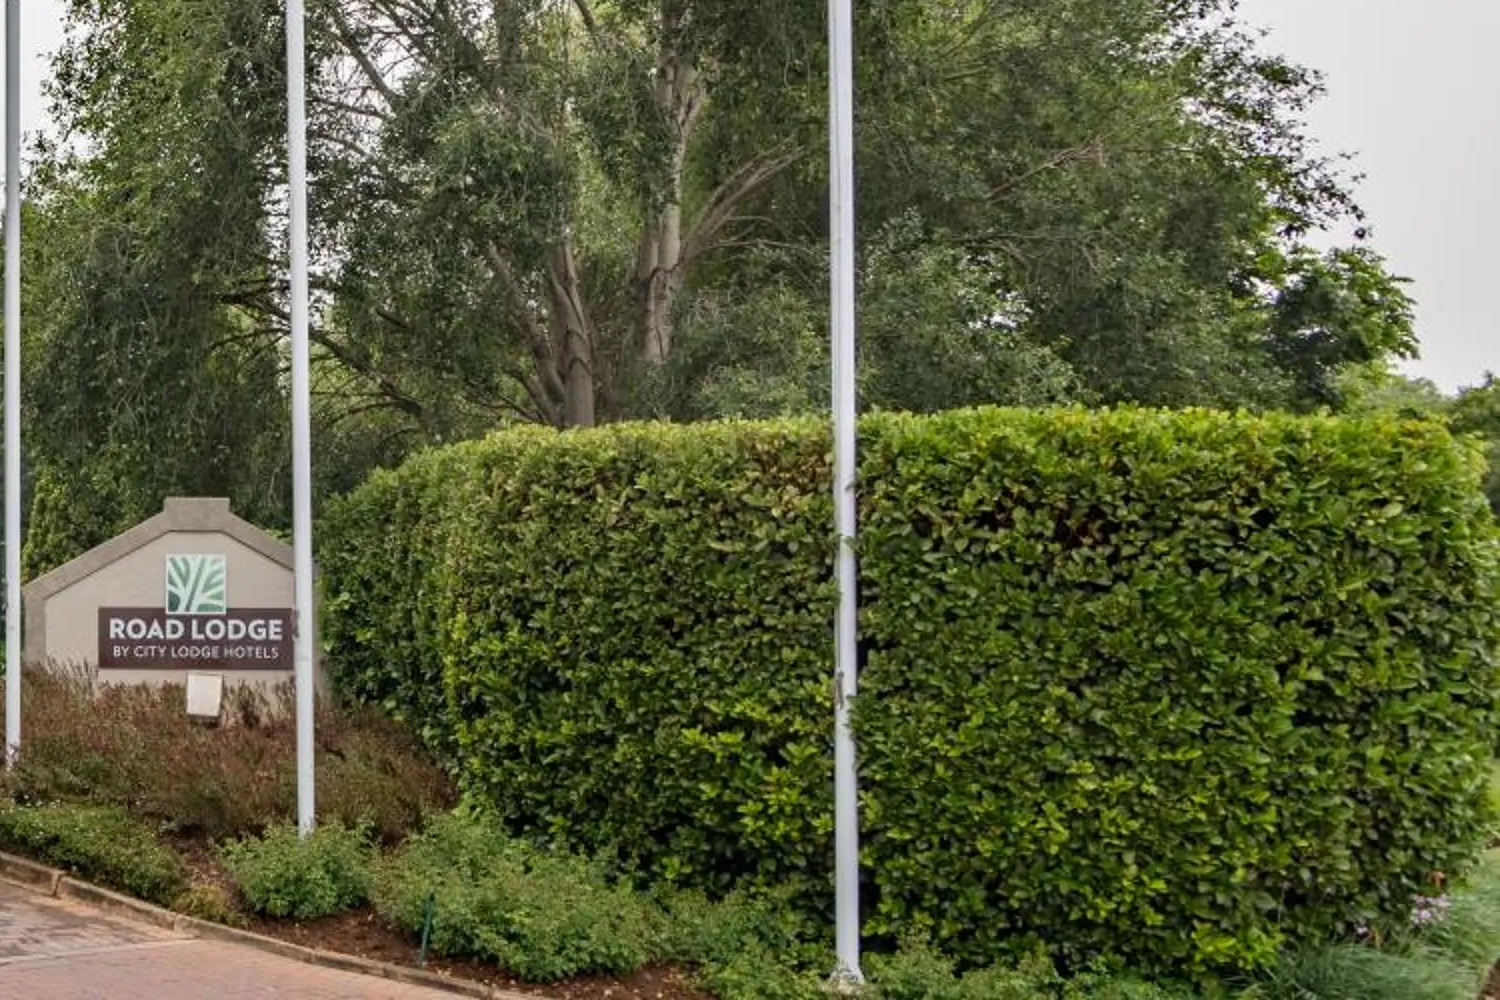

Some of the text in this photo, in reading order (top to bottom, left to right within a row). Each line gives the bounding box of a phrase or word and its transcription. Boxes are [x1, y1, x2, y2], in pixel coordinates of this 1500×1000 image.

[109, 618, 283, 640] ROAD LODGE
[113, 645, 279, 659] BY CITY LODGE HOTELS
